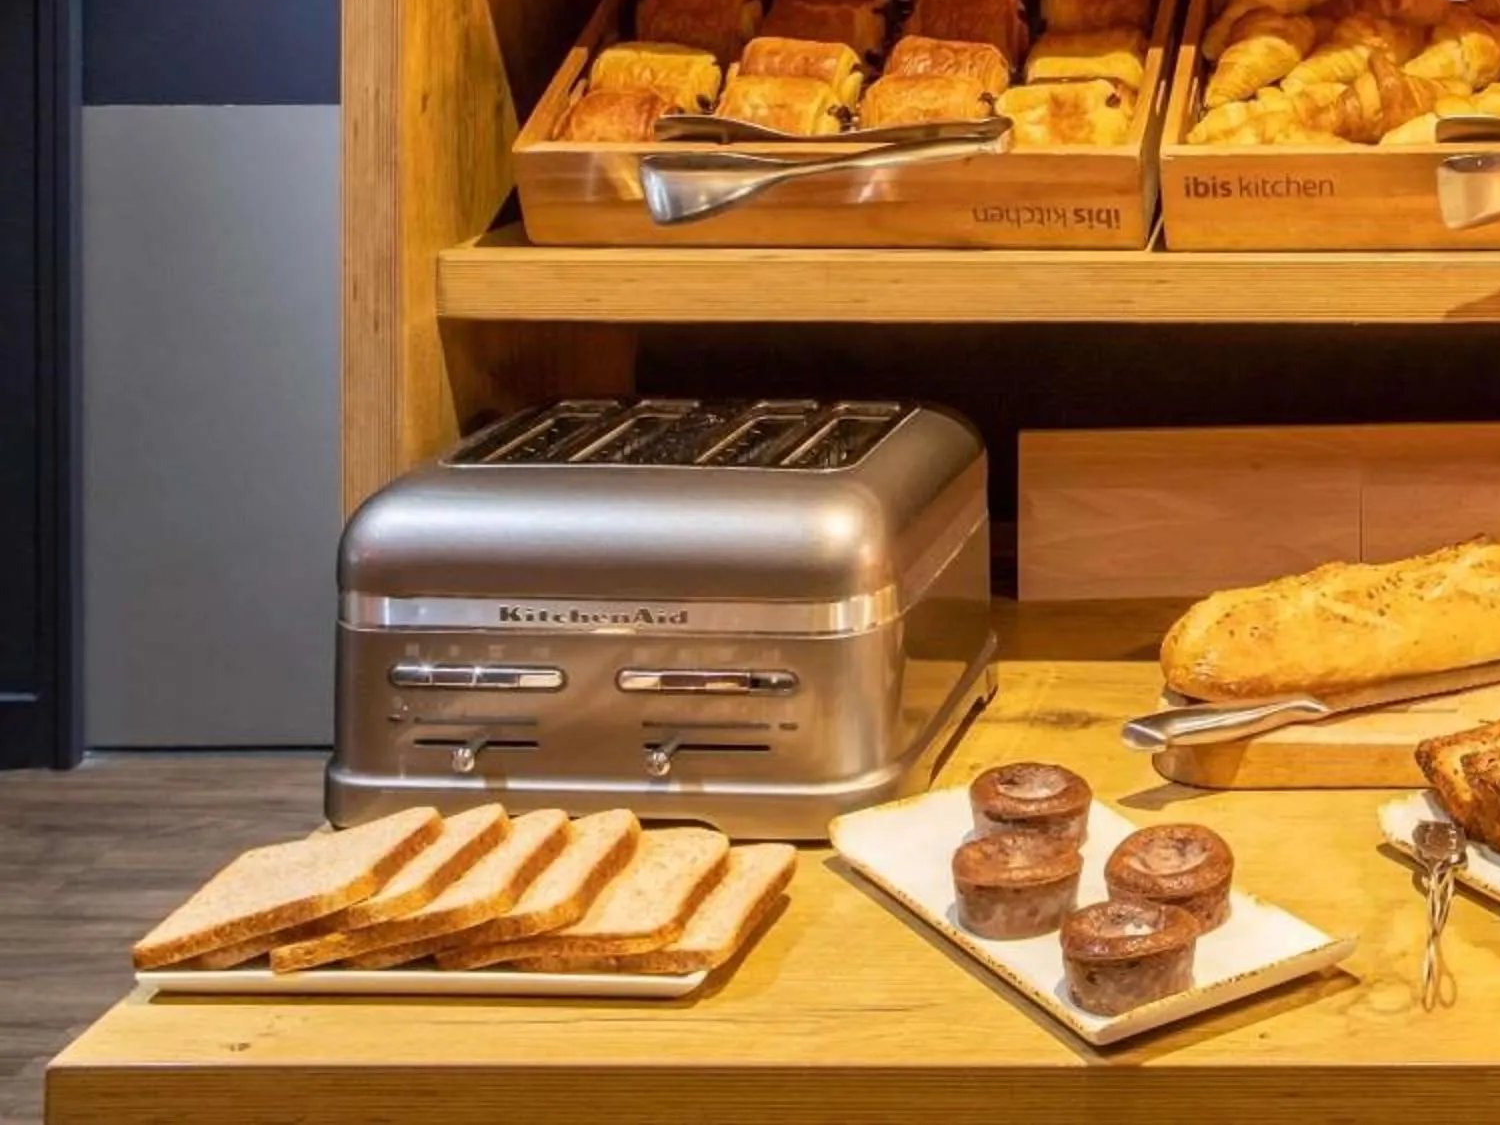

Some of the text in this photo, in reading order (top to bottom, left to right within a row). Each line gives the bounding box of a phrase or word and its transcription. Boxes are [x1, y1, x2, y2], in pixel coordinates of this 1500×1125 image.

[1184, 176, 1335, 198] ibis kitchen
[972, 207, 1120, 230] ibis kitchen
[498, 605, 689, 626] KitchenAid
